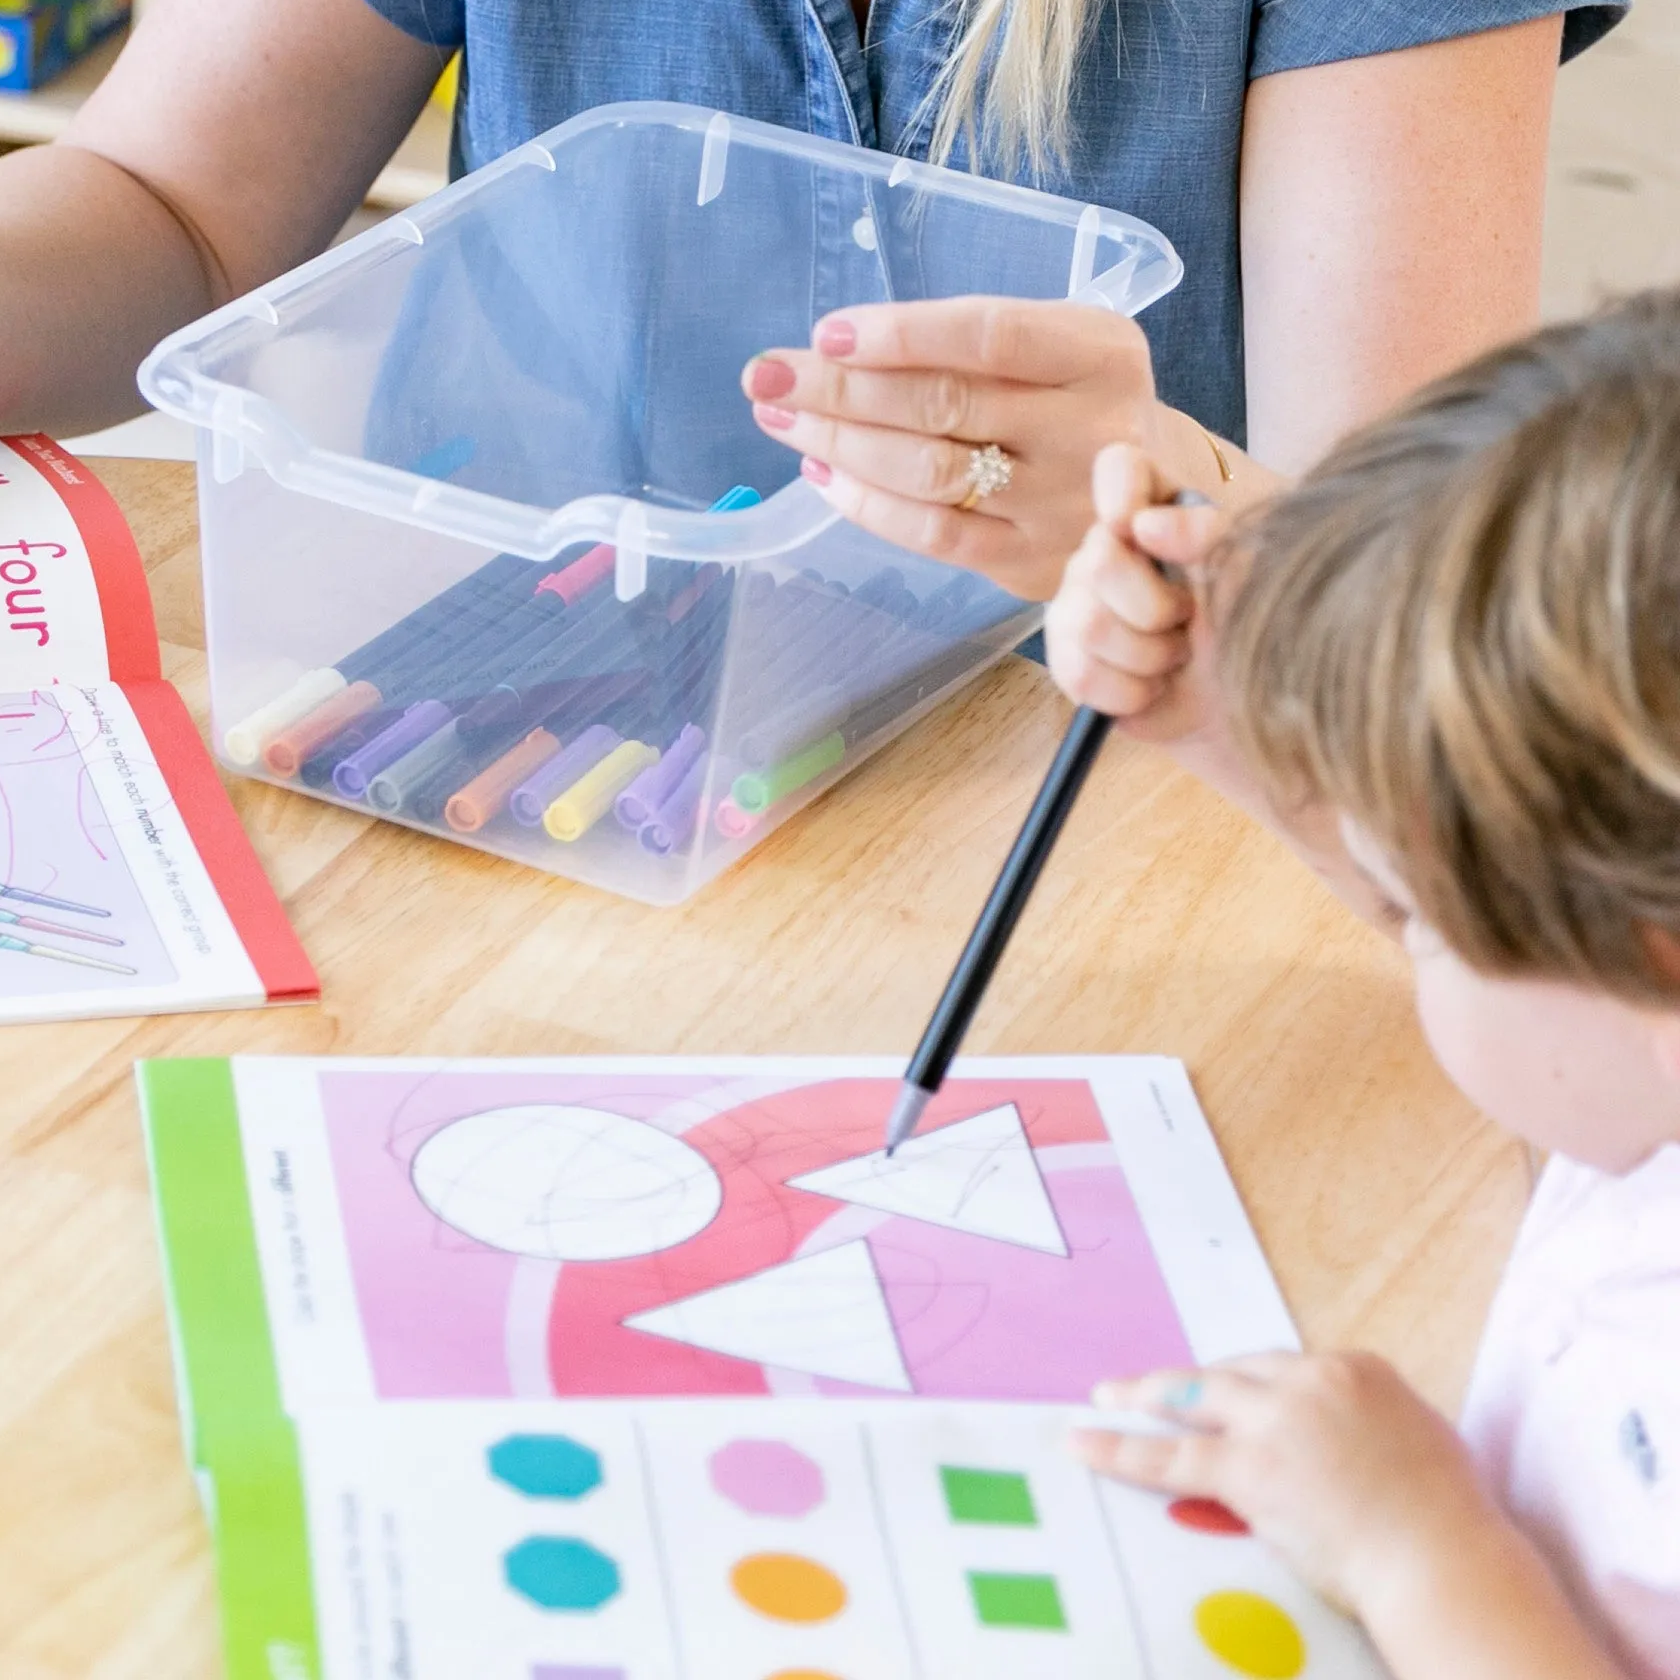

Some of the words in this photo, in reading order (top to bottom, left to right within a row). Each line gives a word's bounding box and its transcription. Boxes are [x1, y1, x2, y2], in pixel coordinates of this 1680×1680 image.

[80, 687, 98, 707] Draw
[99, 718, 115, 735] line
[106, 737, 119, 747] to
[110, 749, 138, 778] match
[124, 781, 149, 805] each
[135, 808, 163, 845] number
[154, 849, 177, 868] with
[166, 871, 186, 886] the
[172, 889, 201, 923] correct
